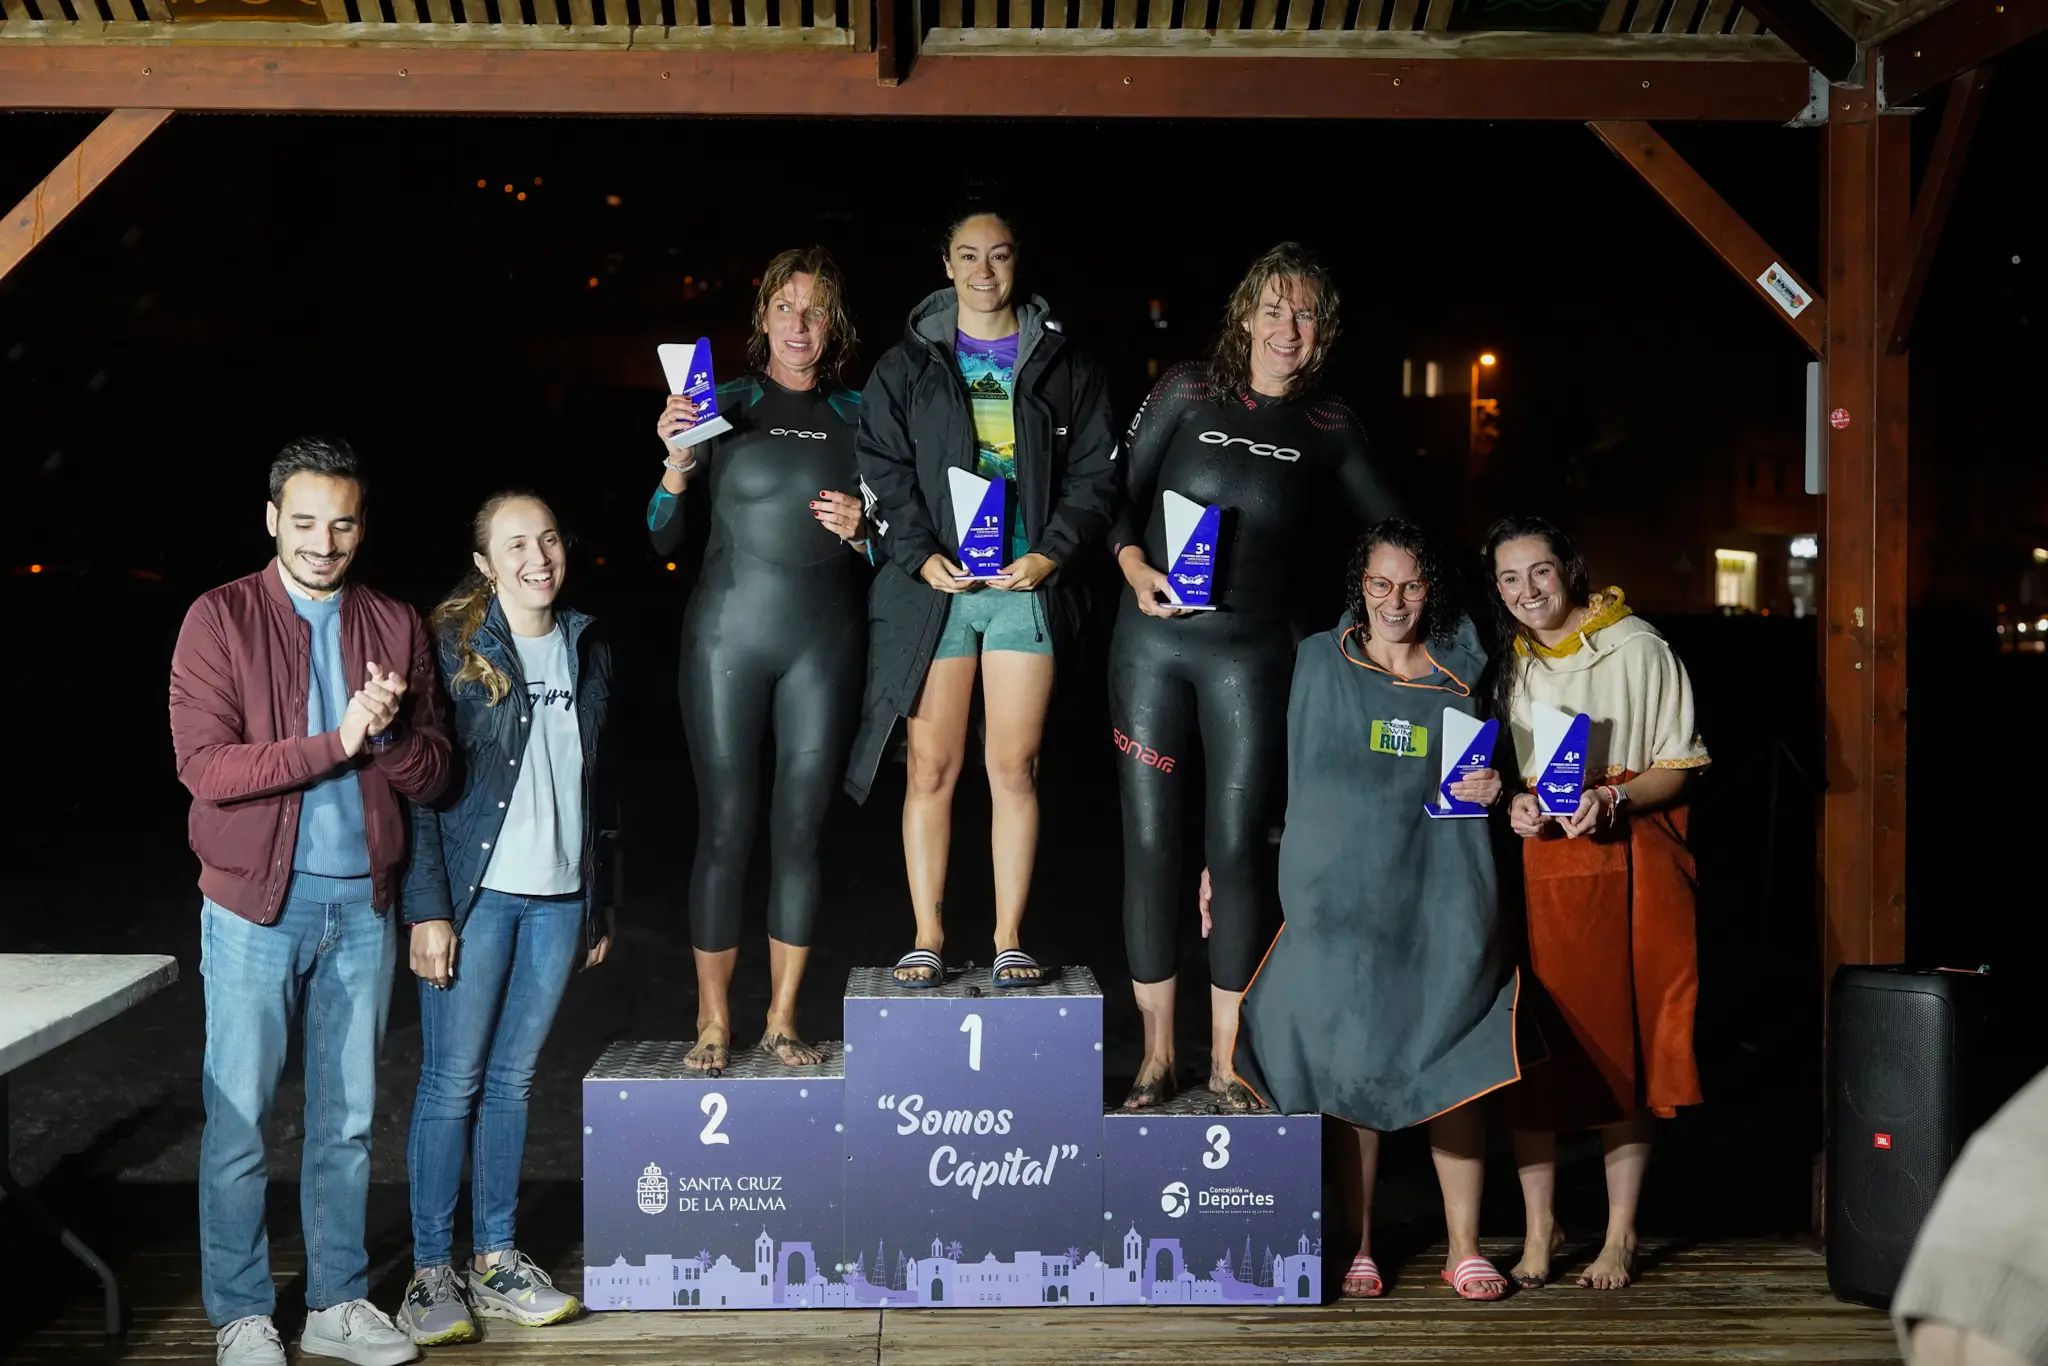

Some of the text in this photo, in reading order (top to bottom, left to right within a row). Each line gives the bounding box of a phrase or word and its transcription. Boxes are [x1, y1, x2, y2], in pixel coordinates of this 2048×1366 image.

[769, 427, 827, 441] orca
[1198, 430, 1301, 463] orca
[960, 1013, 983, 1072] 1
[700, 1093, 730, 1145] 2
[1203, 1124, 1231, 1169] 3
[679, 1176, 782, 1191] SANTA CRUZ
[679, 1197, 786, 1212] DE LA PALMA
[1198, 1191, 1275, 1209] Deportes
